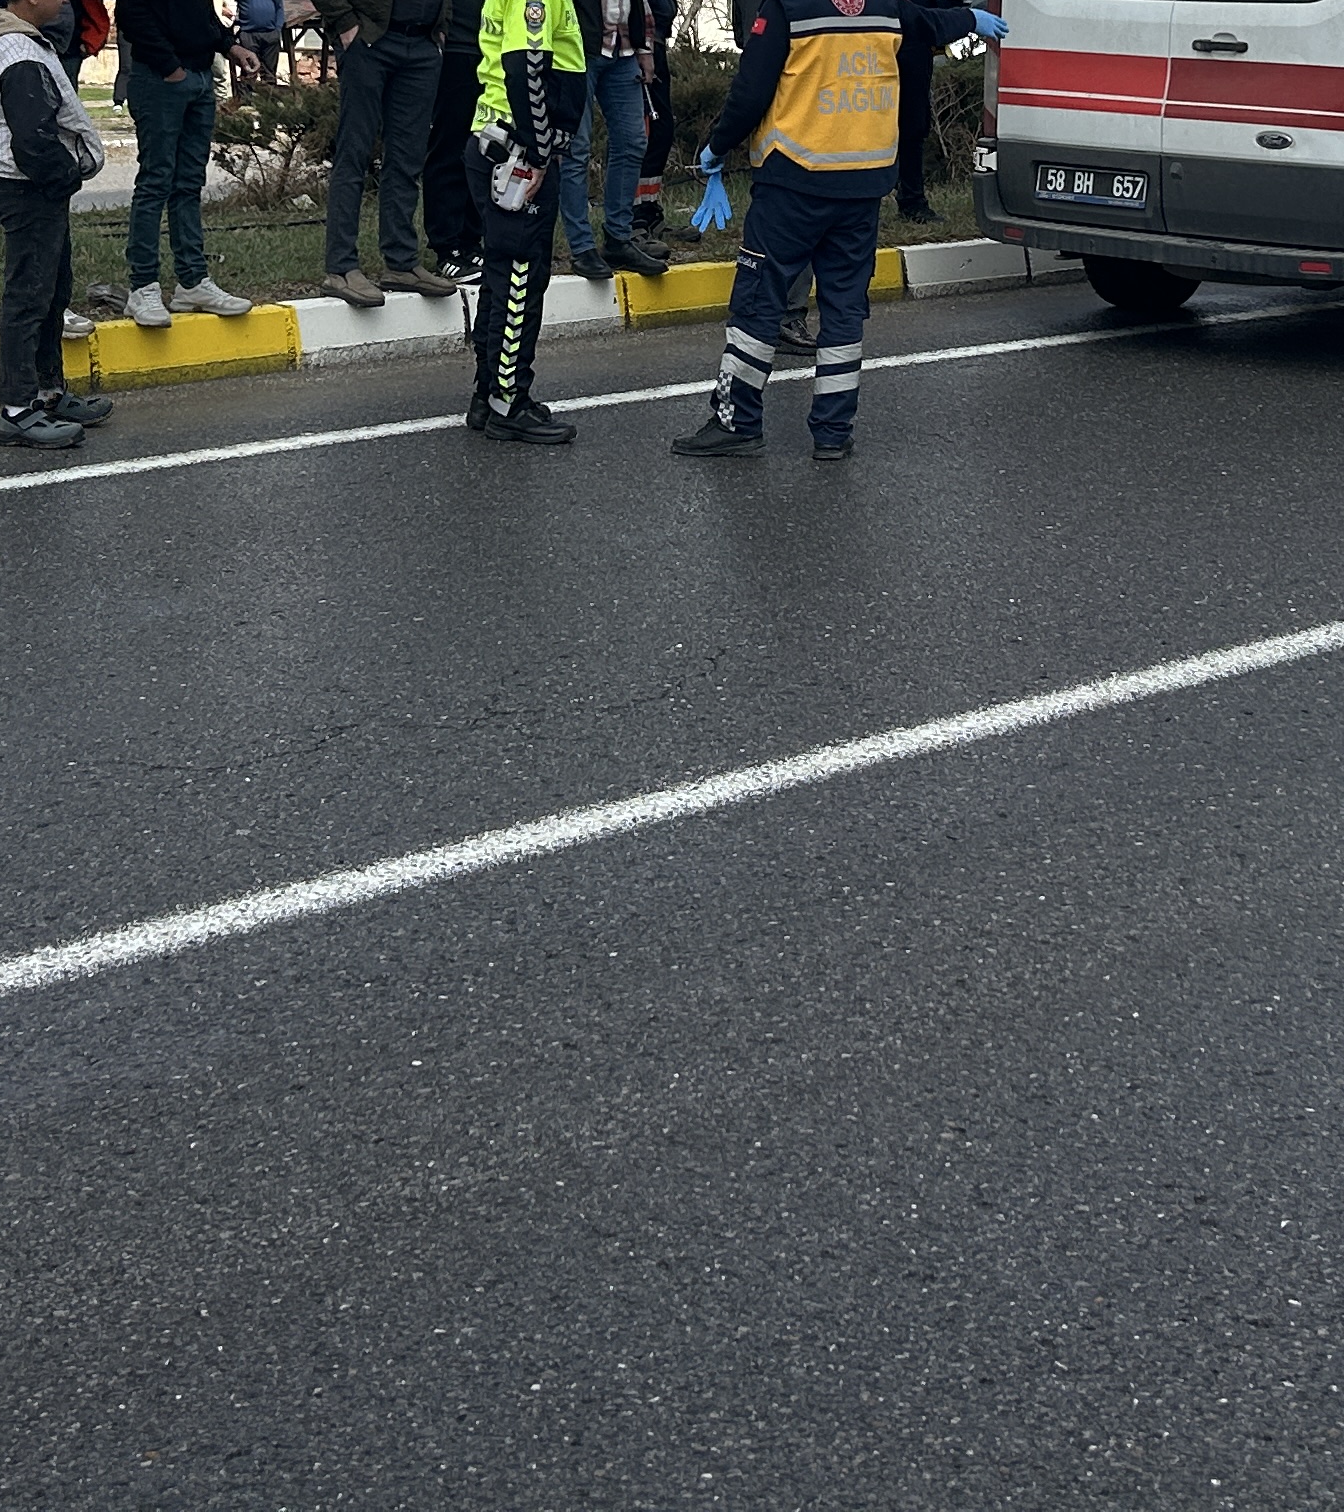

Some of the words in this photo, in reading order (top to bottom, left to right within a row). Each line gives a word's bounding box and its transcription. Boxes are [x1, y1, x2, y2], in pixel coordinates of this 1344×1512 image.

[837, 44, 885, 78] ACİL
[1046, 169, 1066, 191] 58
[1073, 171, 1094, 194] BH
[1113, 175, 1144, 199] 657
